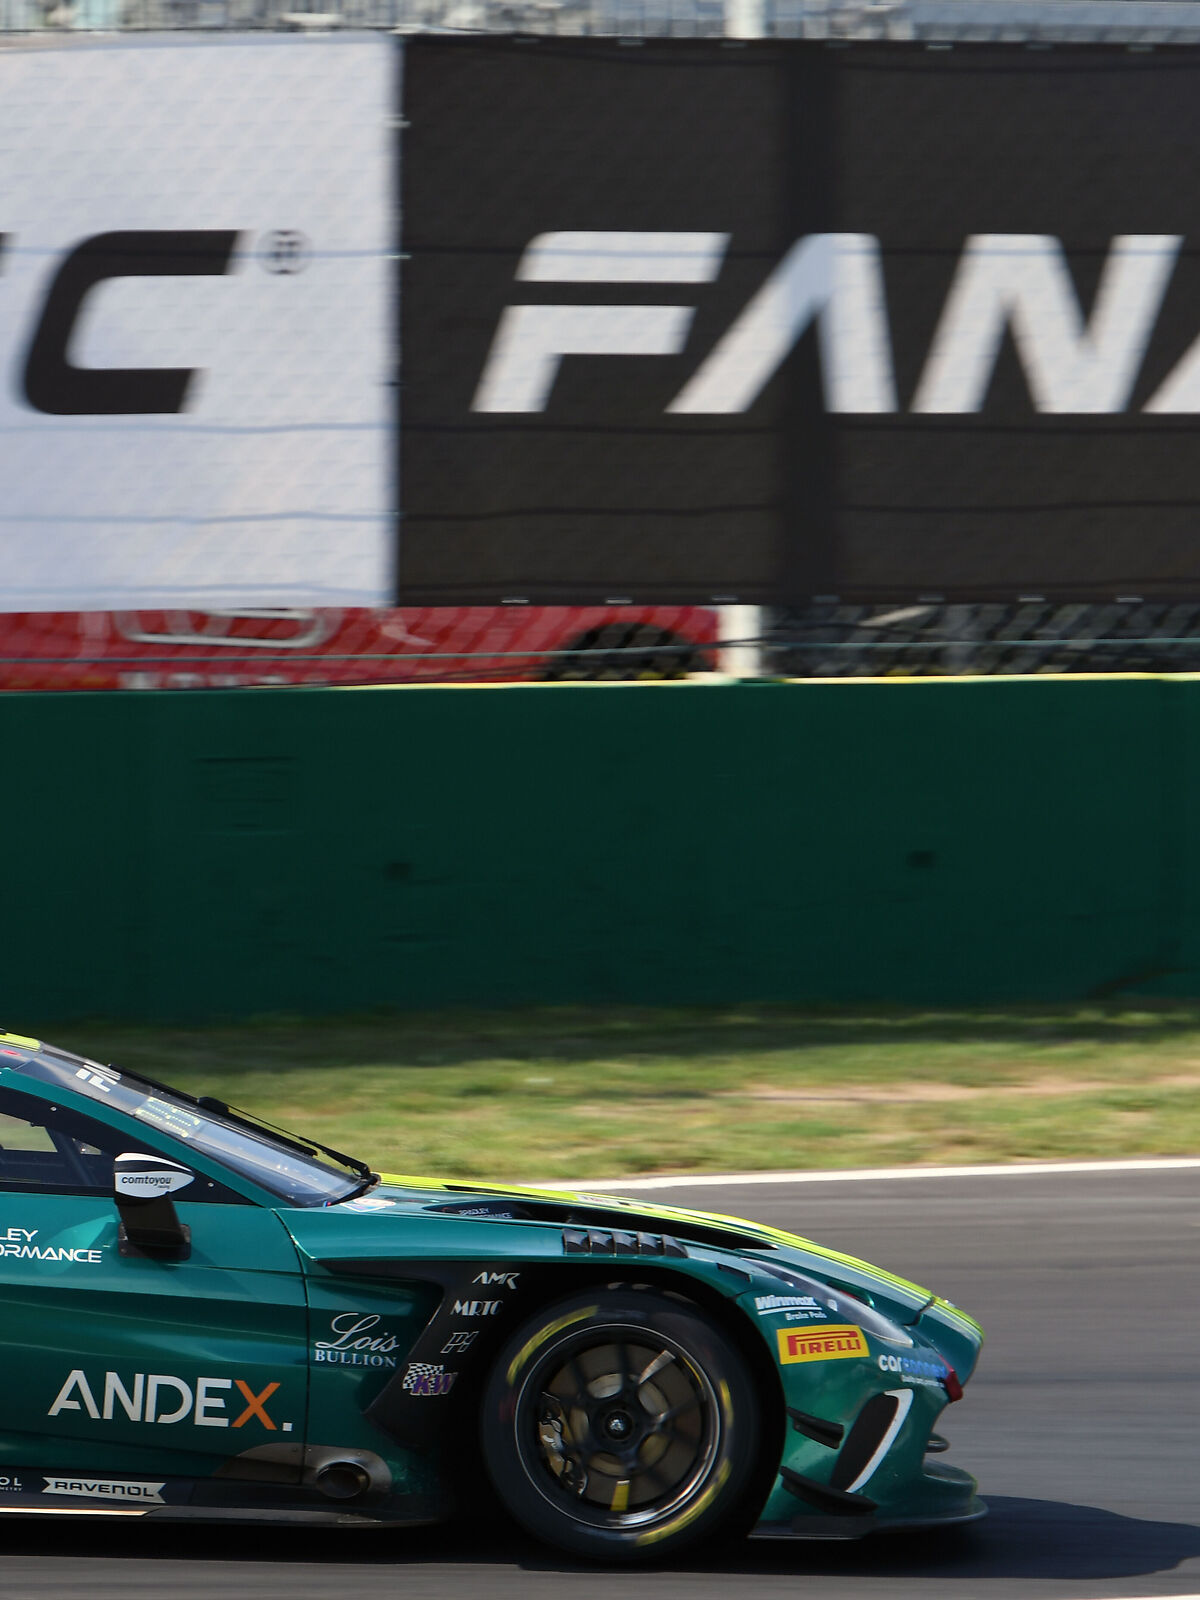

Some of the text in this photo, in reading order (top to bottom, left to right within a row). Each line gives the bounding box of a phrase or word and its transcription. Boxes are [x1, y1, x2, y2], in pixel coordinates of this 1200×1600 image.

[121, 1176, 172, 1186] comtoyou
[315, 1312, 399, 1352] Lois
[787, 1330, 861, 1357] PIRELLI
[314, 1349, 397, 1368] BULLION
[54, 1481, 155, 1498] RAVENOL
